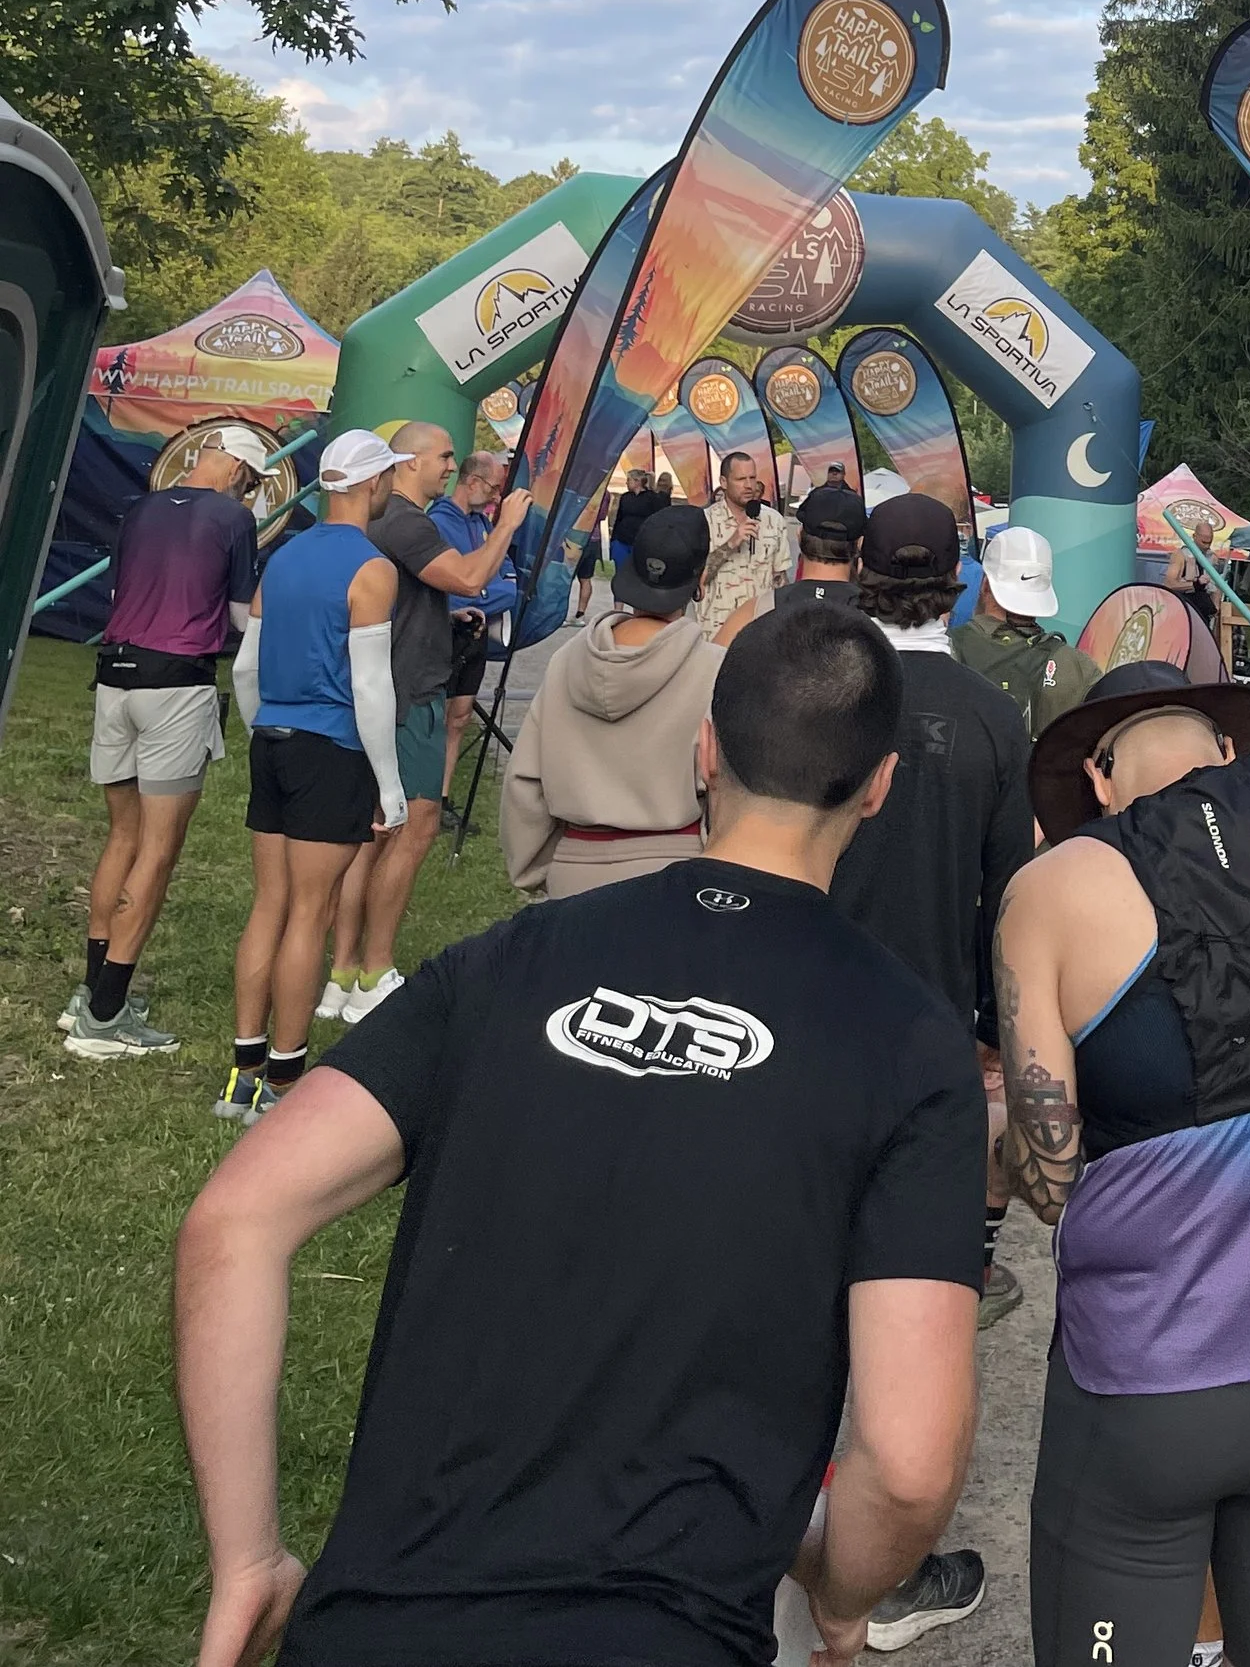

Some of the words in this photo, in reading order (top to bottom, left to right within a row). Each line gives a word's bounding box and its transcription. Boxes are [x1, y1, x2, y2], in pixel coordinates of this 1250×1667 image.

[834, 7, 889, 42] HAPPY
[833, 34, 882, 75] TRAILS
[823, 86, 858, 108] RACING
[222, 323, 269, 335] HAPPY
[455, 347, 486, 371] LA
[487, 274, 584, 350] SPORTIV
[748, 302, 804, 313] RACING
[946, 293, 971, 319] LA
[971, 316, 1057, 398] SPORTIVA
[1201, 802, 1230, 869] SALOMON
[578, 986, 748, 1070] DTS
[576, 1029, 644, 1060] FITNESS
[645, 1050, 732, 1081] EDUCATION
